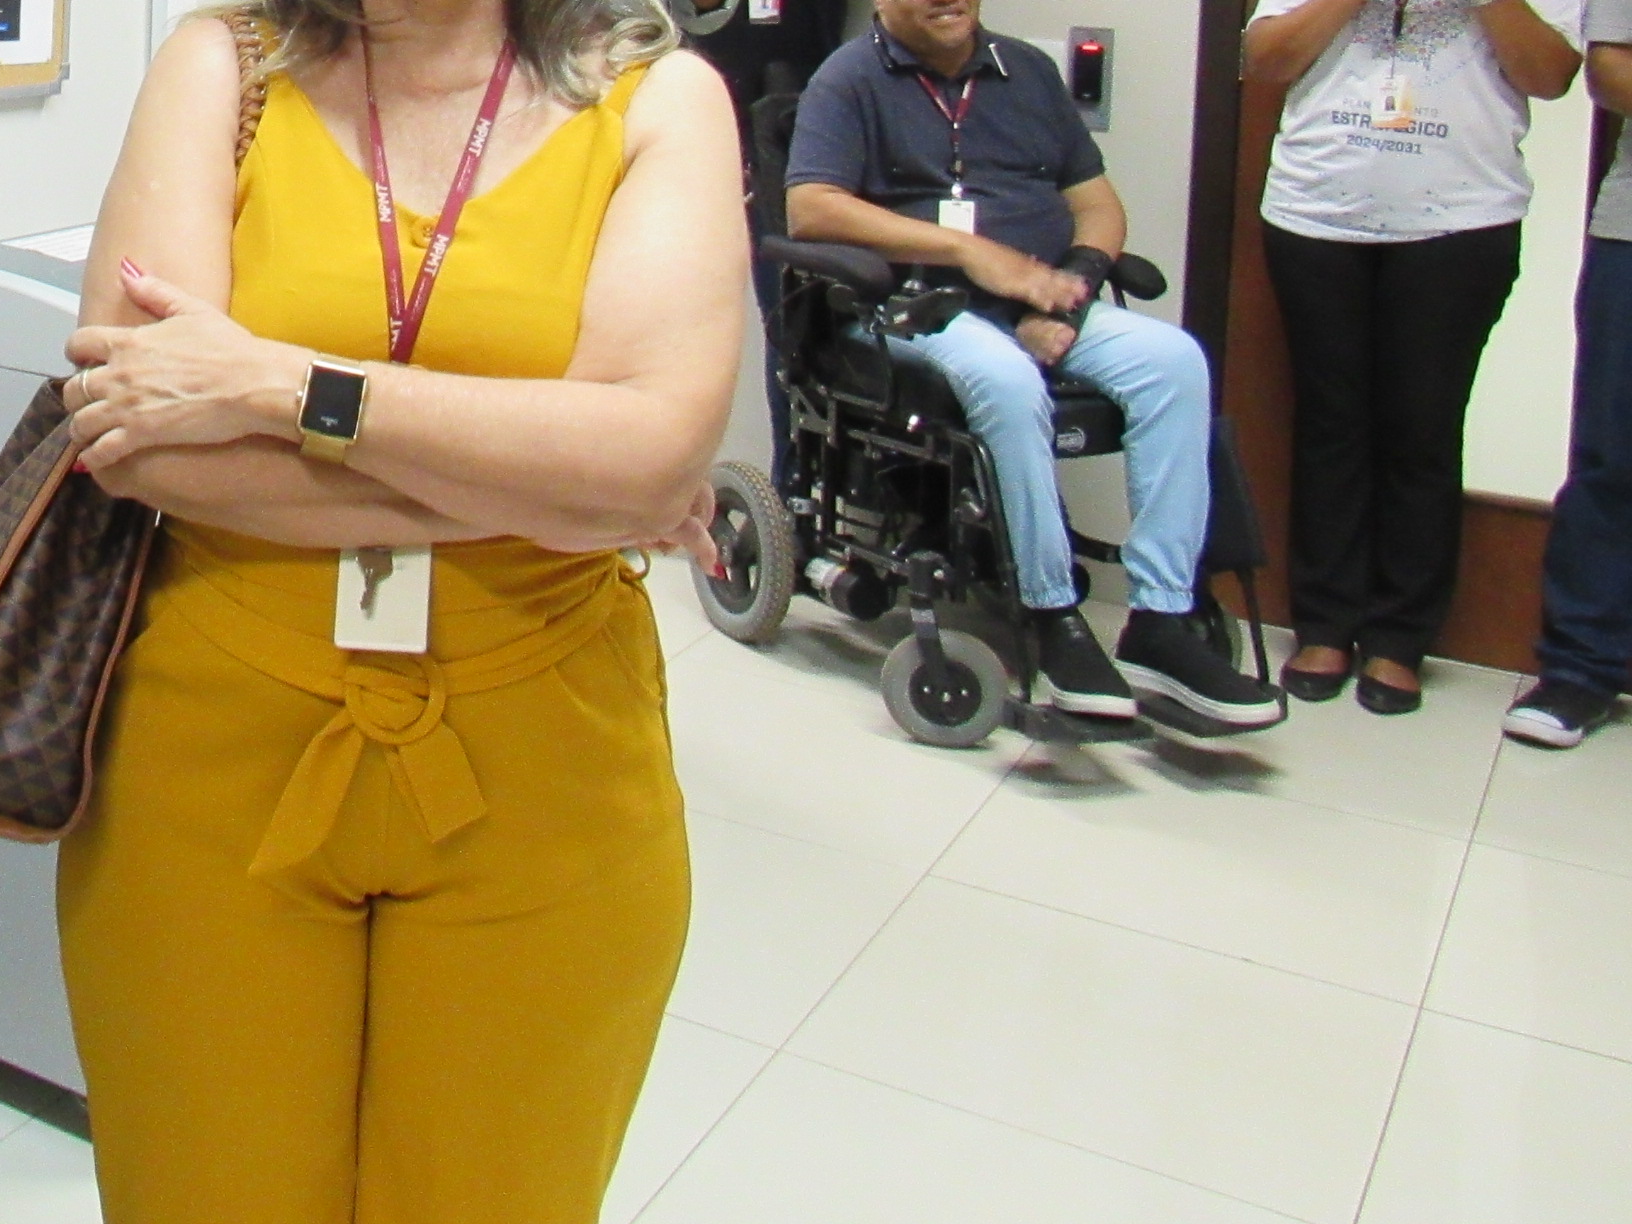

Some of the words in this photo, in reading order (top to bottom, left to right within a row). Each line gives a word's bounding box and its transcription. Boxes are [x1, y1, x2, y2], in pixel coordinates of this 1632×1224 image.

[468, 117, 493, 159] MPMT
[374, 181, 393, 223] MPMT
[424, 232, 450, 277] MPMT
